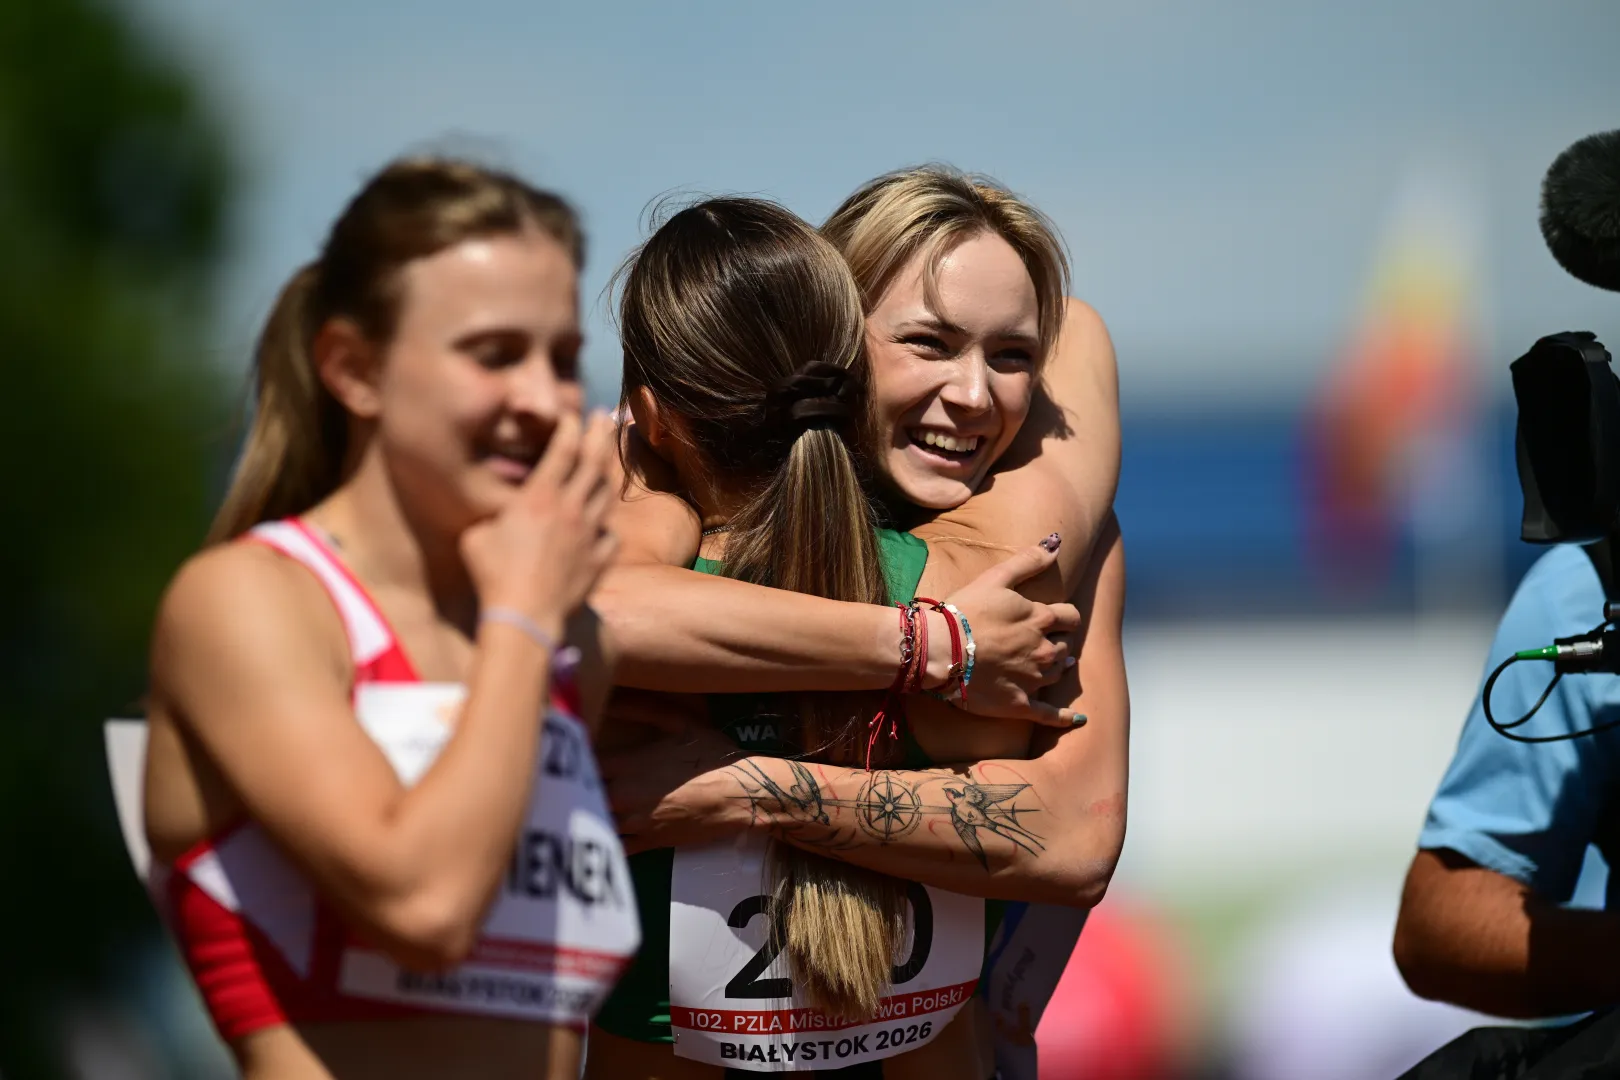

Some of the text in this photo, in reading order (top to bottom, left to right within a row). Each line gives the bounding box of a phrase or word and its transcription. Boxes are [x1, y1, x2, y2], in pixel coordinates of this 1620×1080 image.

[724, 881, 934, 998] 20
[689, 1011, 727, 1030] 102.
[734, 1015, 783, 1032] PZLA
[912, 986, 963, 1013] Polski
[720, 1021, 933, 1063] BIAŁYSTOK 2026
